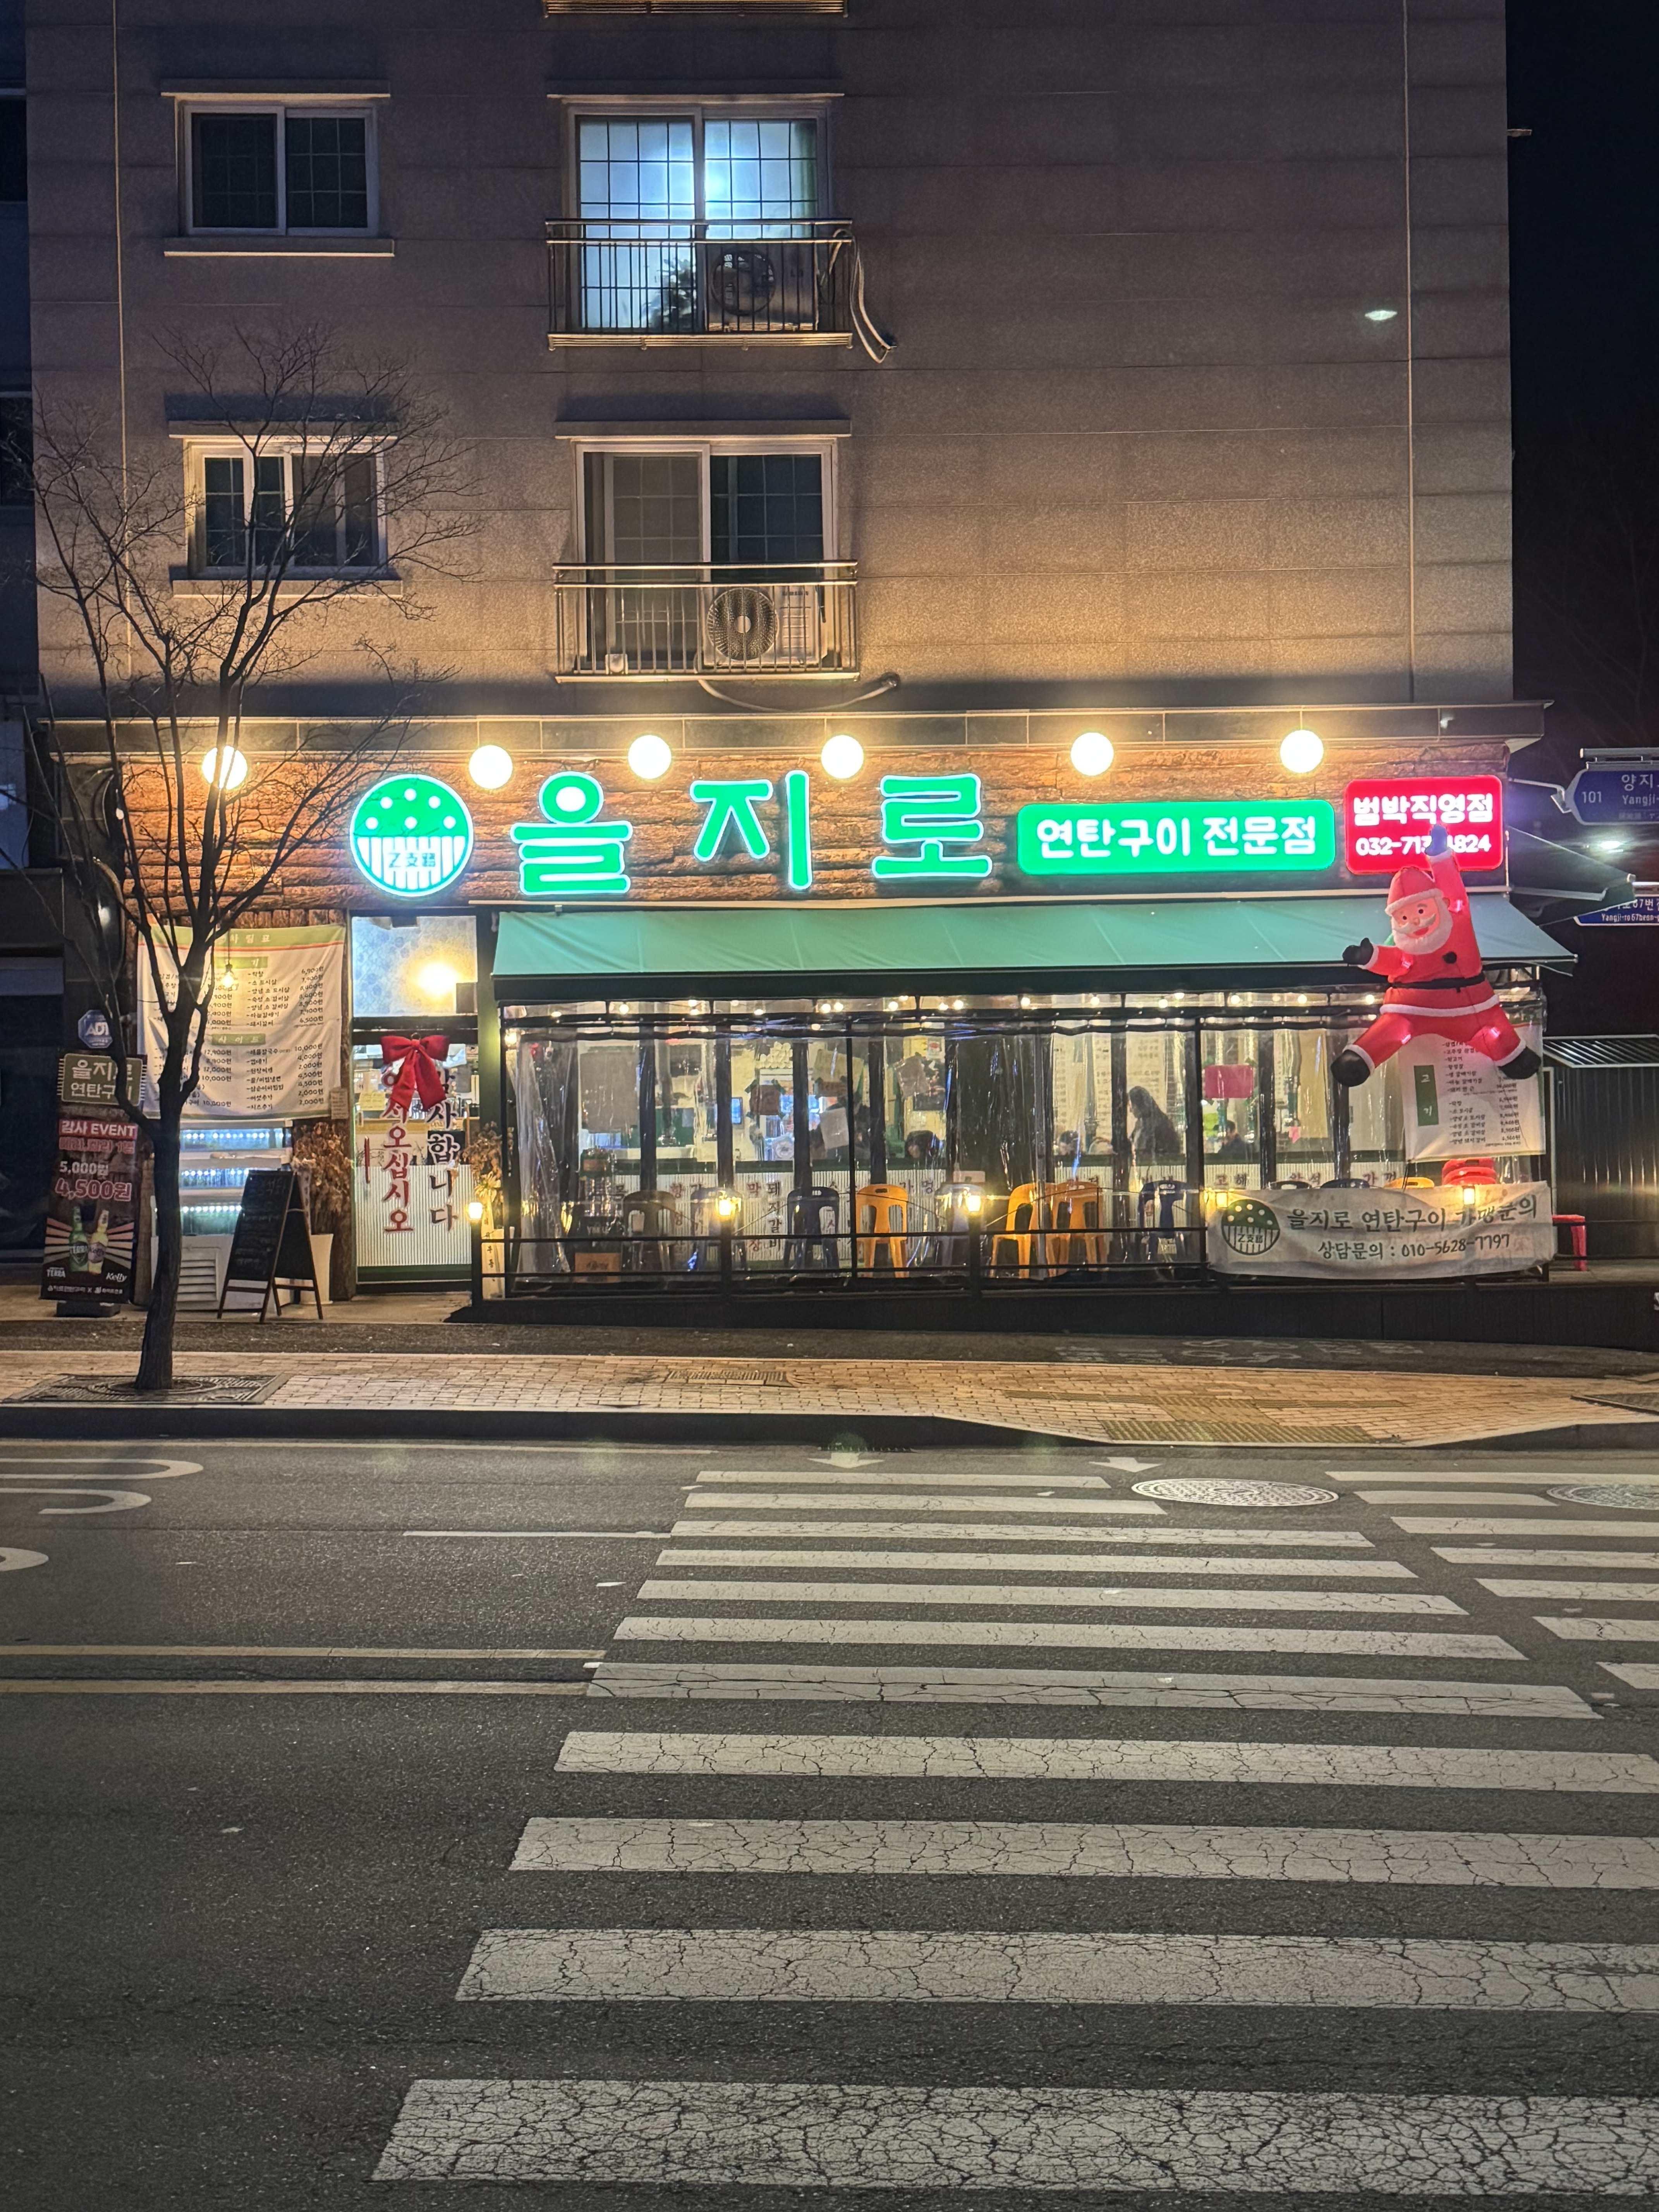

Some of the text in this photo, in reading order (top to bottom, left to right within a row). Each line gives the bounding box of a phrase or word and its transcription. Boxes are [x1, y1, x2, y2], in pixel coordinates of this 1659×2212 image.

[1621, 774, 1659, 791] 양지
[1582, 791, 1602, 803] 101
[1353, 793, 1493, 826] 범박직영점
[511, 769, 992, 895] 을지로
[1036, 816, 1316, 858] 연탄구이 전문점
[1356, 834, 1492, 856] 032-713824
[62, 1120, 136, 1137] 감사 EVENT
[59, 1161, 109, 1176] 5,000원
[55, 1177, 132, 1202] 4,500원
[1287, 1208, 1353, 1231] 을지로
[1362, 1208, 1445, 1233] 연탄구이
[1318, 1240, 1383, 1260] 상담문의
[1401, 1234, 1510, 1257] 010-5628-7797
[105, 1272, 127, 1283] Kelly
